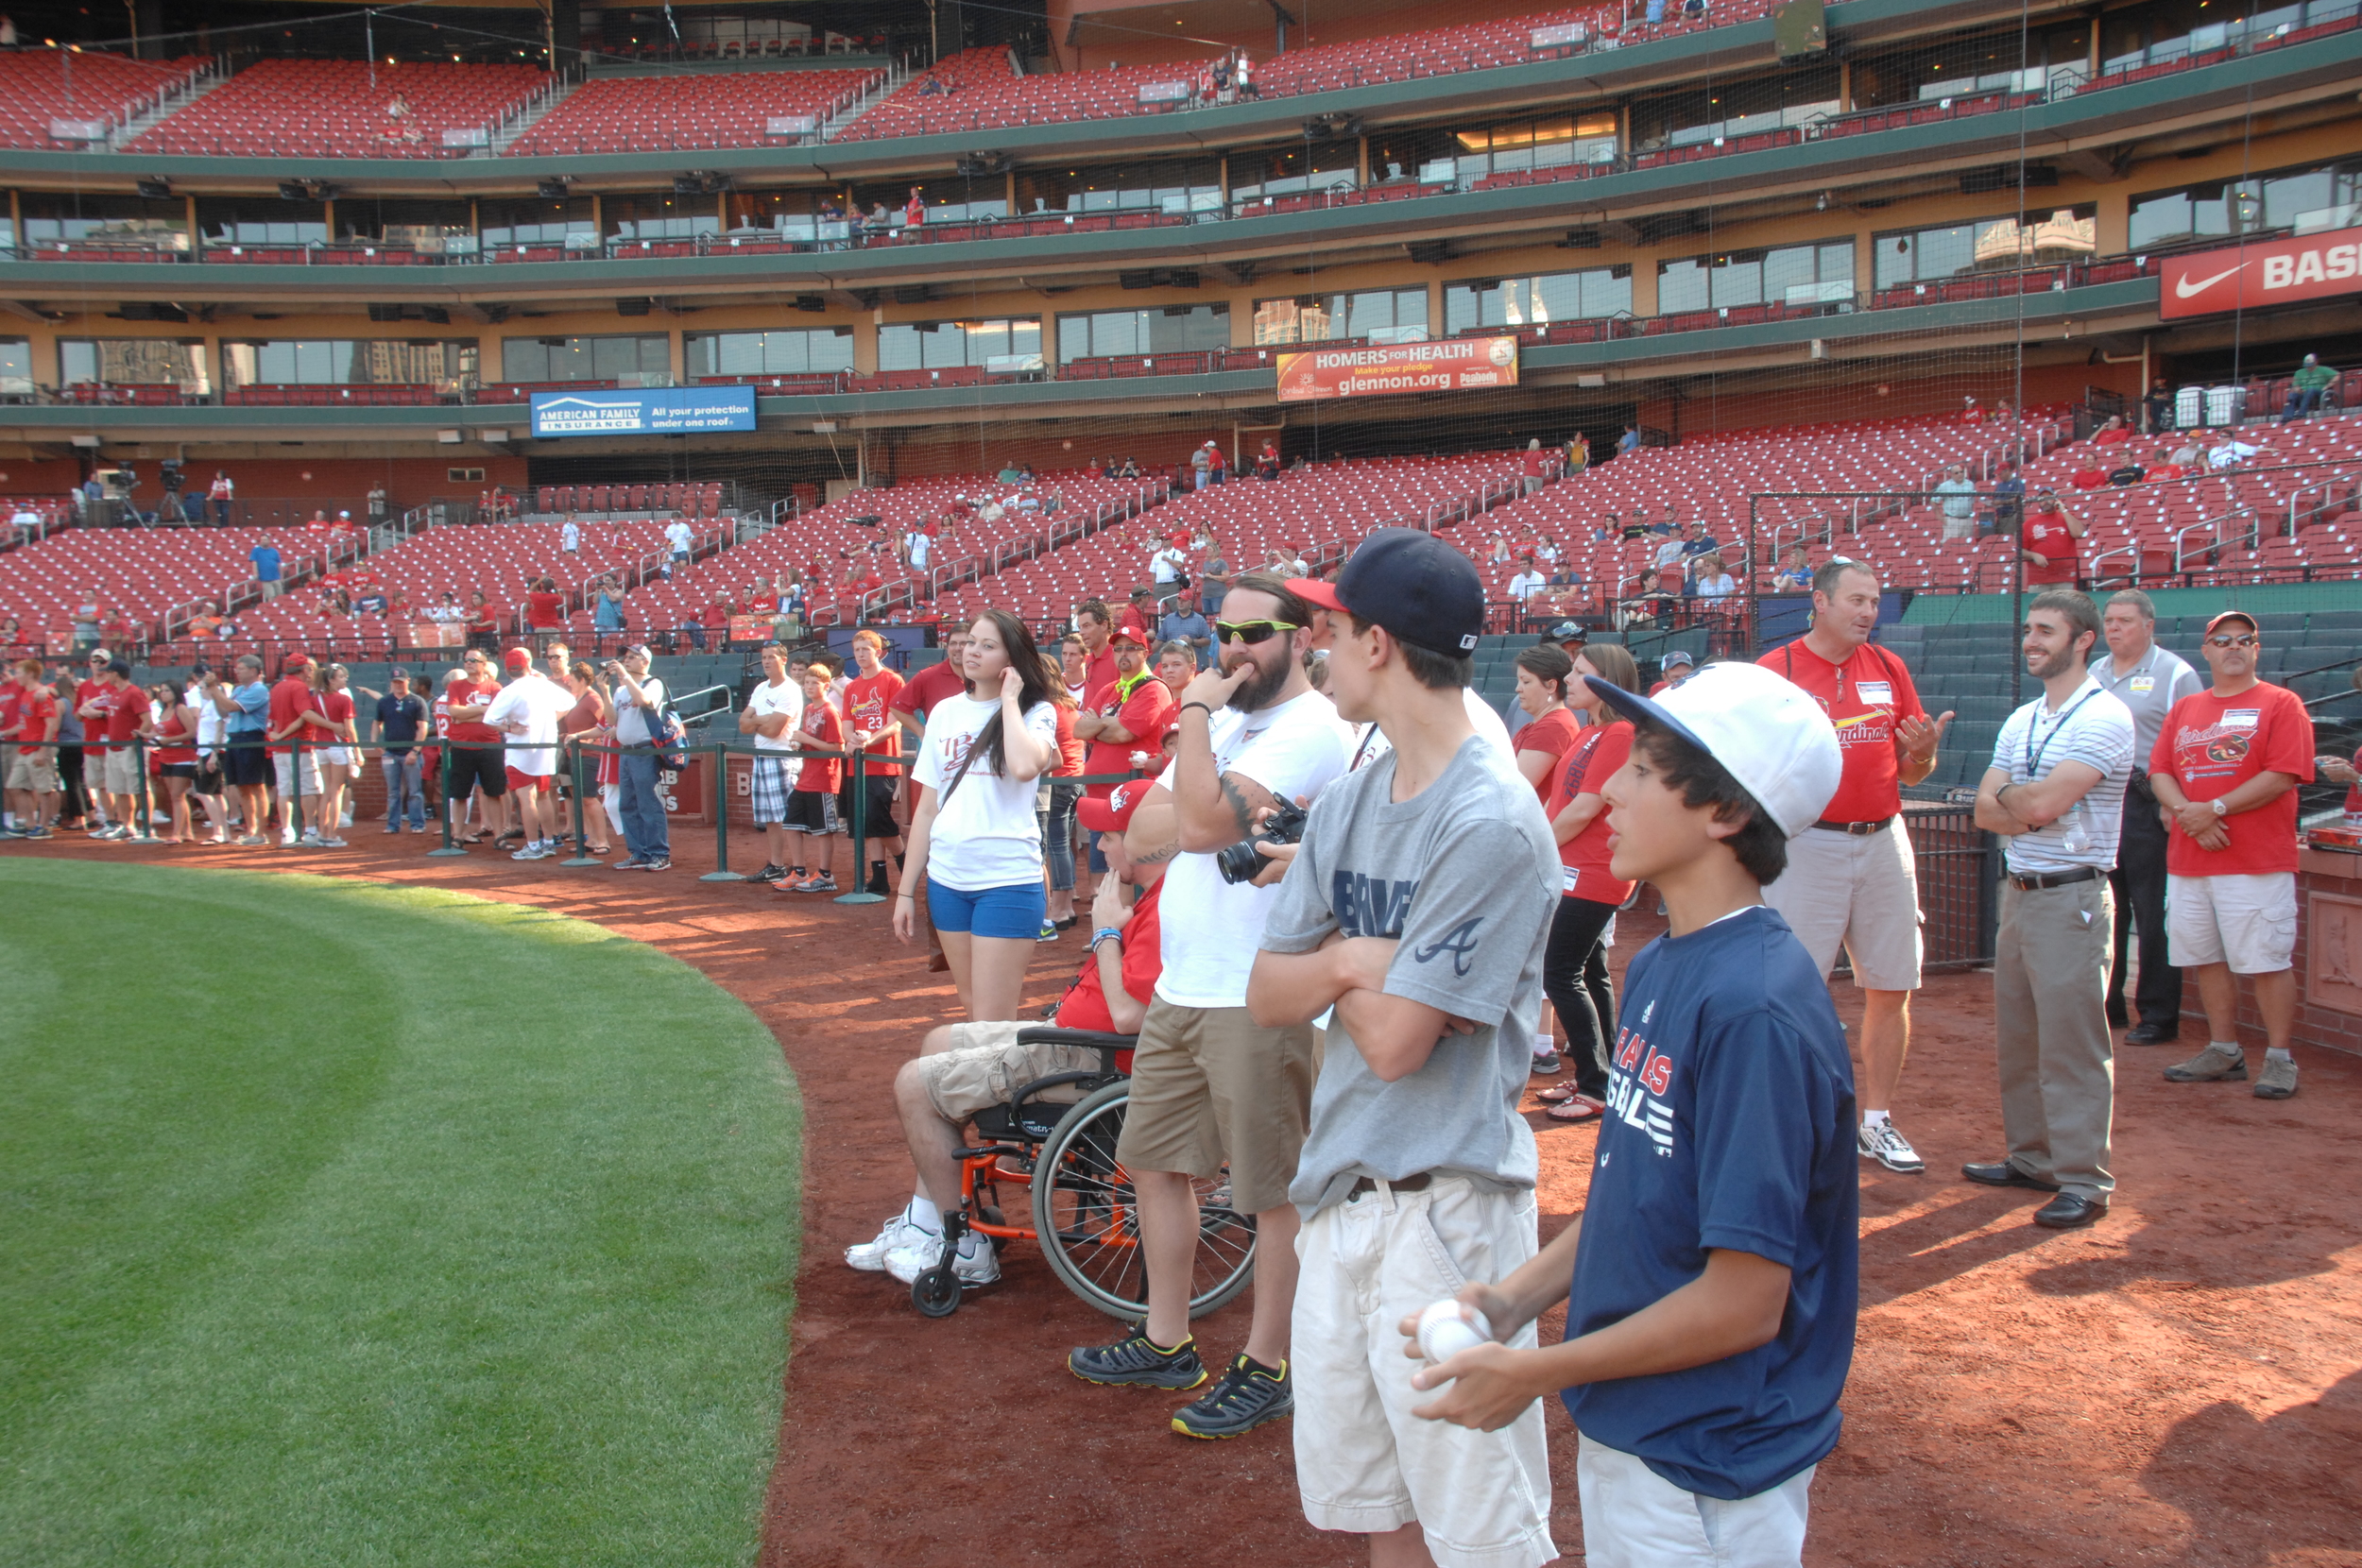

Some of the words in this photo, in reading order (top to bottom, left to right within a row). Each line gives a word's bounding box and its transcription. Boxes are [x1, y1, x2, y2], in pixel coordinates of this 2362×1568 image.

[2264, 243, 2362, 290] BAS
[1317, 349, 1388, 369] HOMERS
[1389, 351, 1408, 361] FOR
[1410, 343, 1474, 362] HEALTH
[1355, 366, 1378, 376] Make
[1380, 365, 1400, 374] your
[1402, 363, 1433, 373] pledge
[1339, 372, 1451, 396] glennon.org
[1460, 371, 1498, 384] Peabody
[539, 410, 596, 421] AMERICAN
[601, 408, 640, 419] FAMILY
[669, 408, 692, 418] your
[694, 405, 749, 417] protection
[652, 419, 683, 428] under
[707, 418, 728, 426] roof
[867, 716, 883, 729] 23
[1837, 722, 1890, 742] ardinals
[1415, 916, 1485, 977] A
